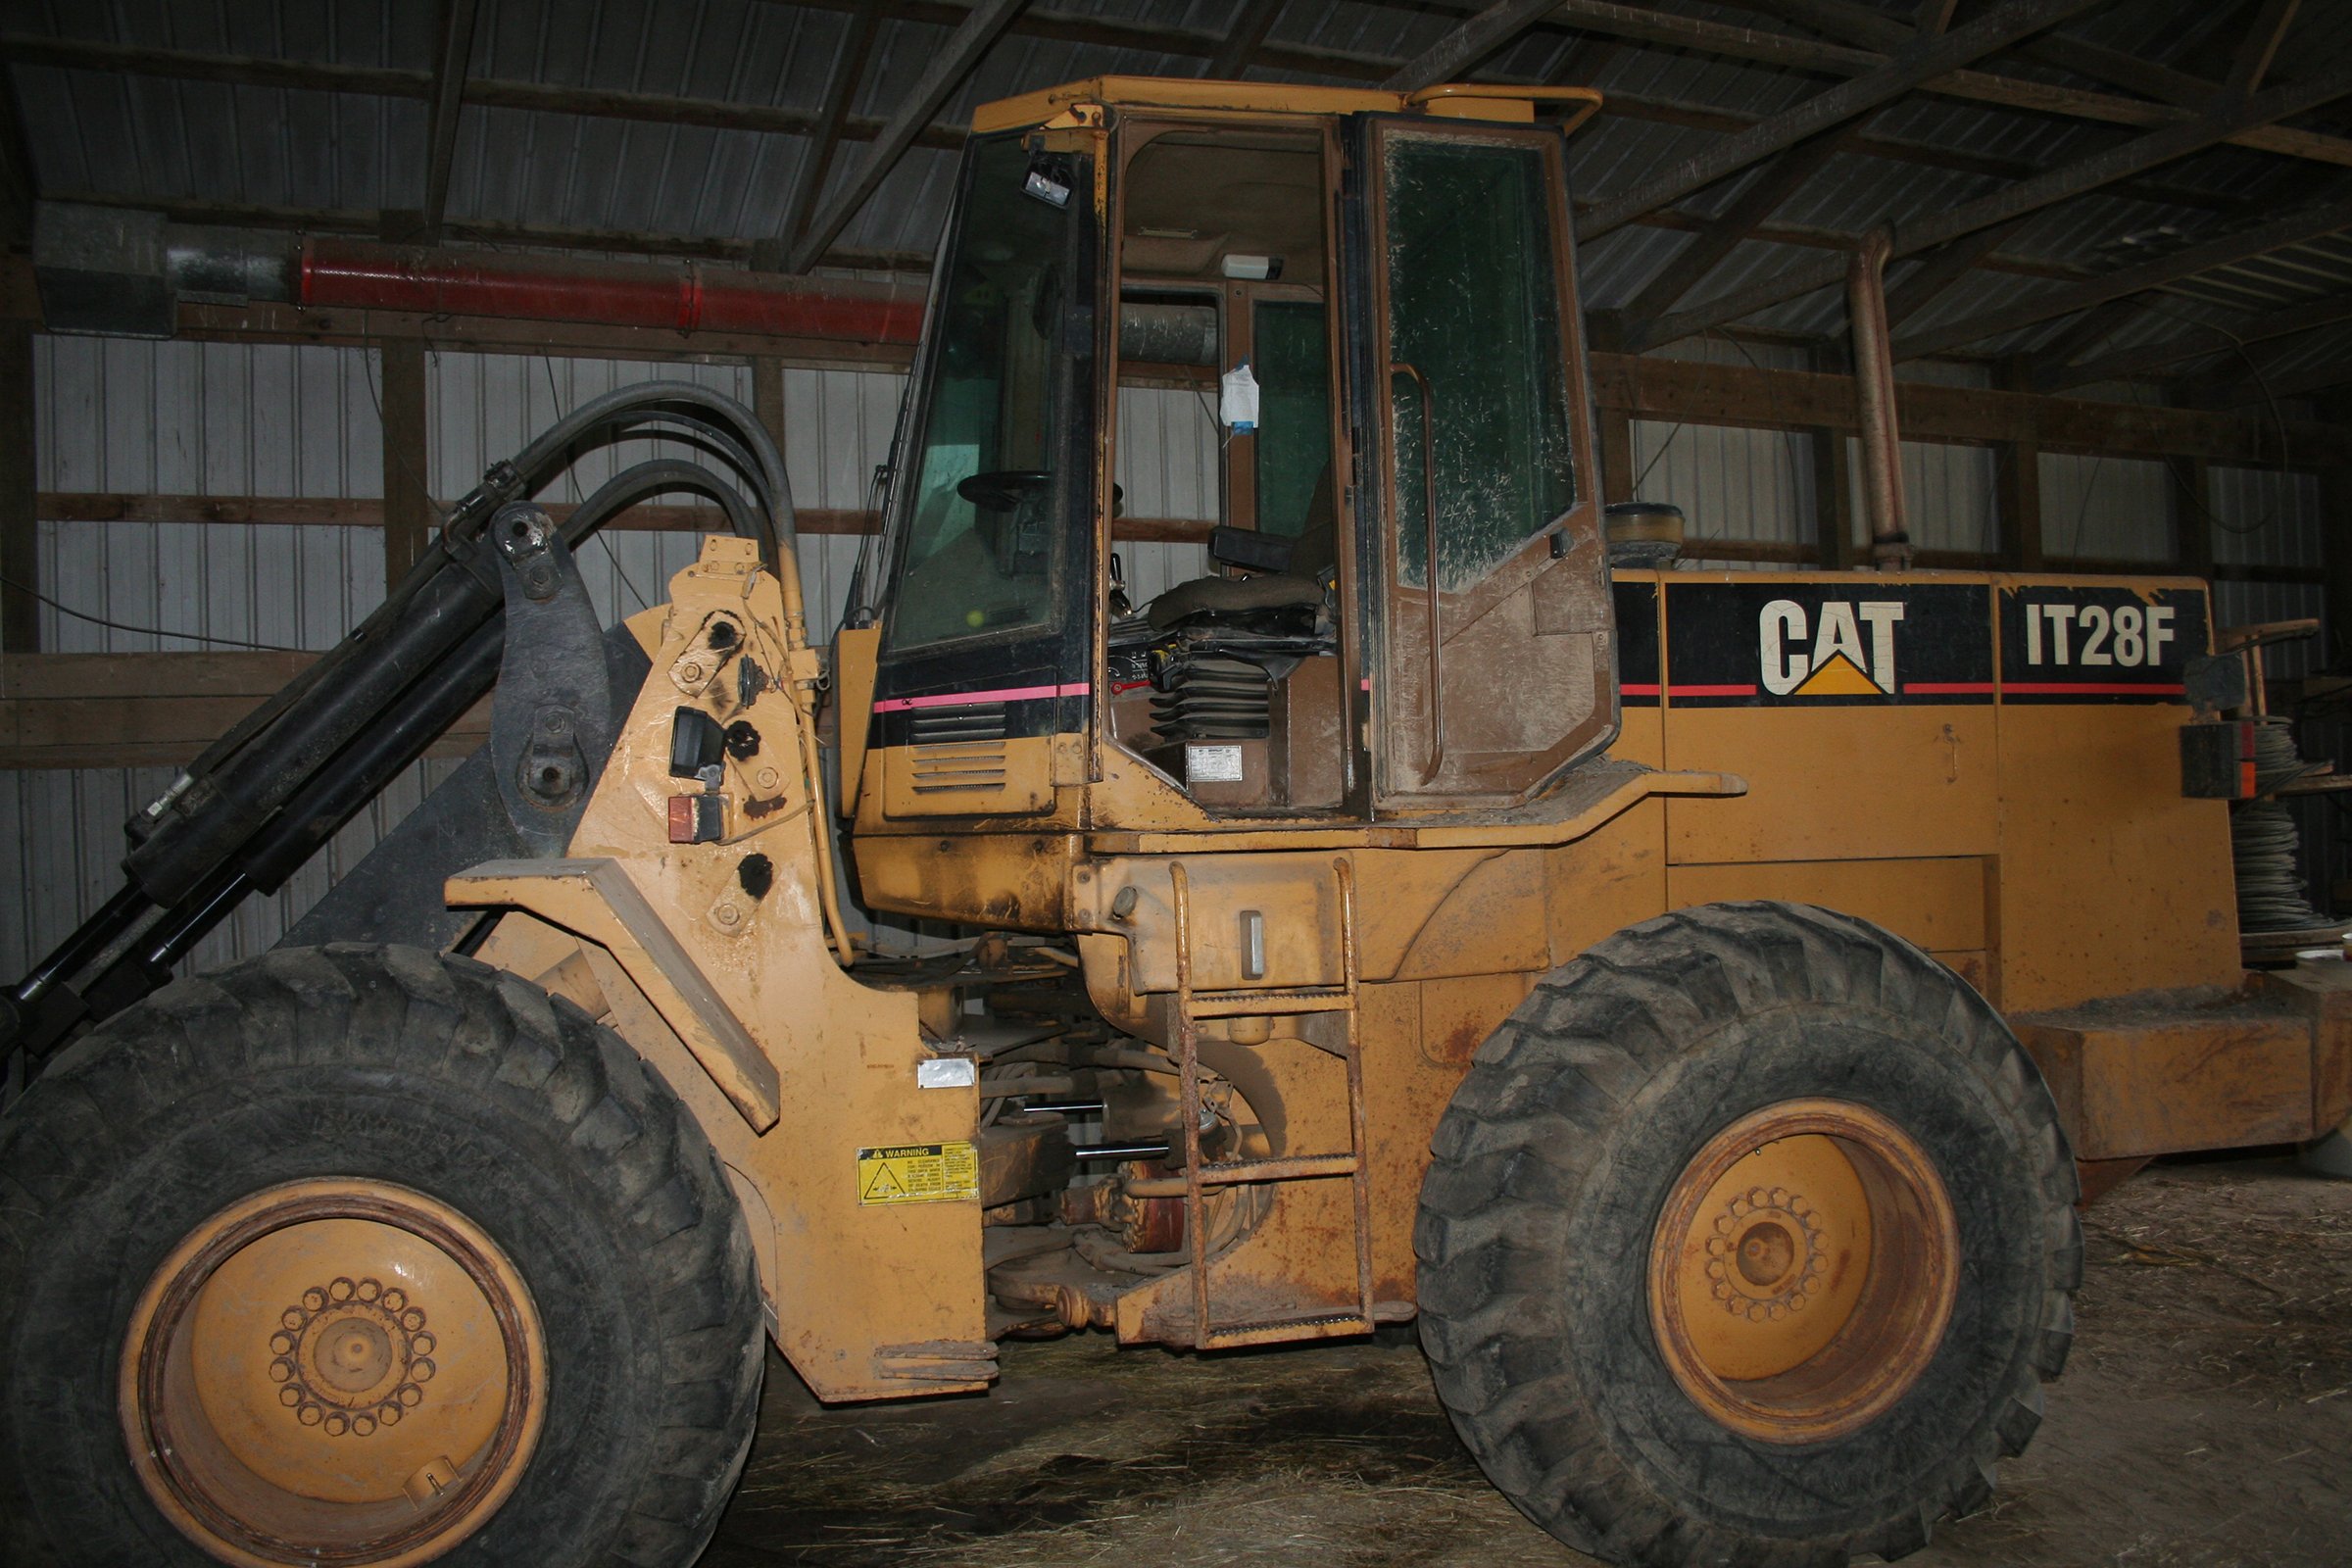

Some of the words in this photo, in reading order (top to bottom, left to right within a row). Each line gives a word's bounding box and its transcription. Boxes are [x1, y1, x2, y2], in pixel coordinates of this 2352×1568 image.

[1759, 600, 1904, 695] CAT
[2026, 604, 2175, 666] IT28F
[886, 1148, 929, 1158] WARNING
